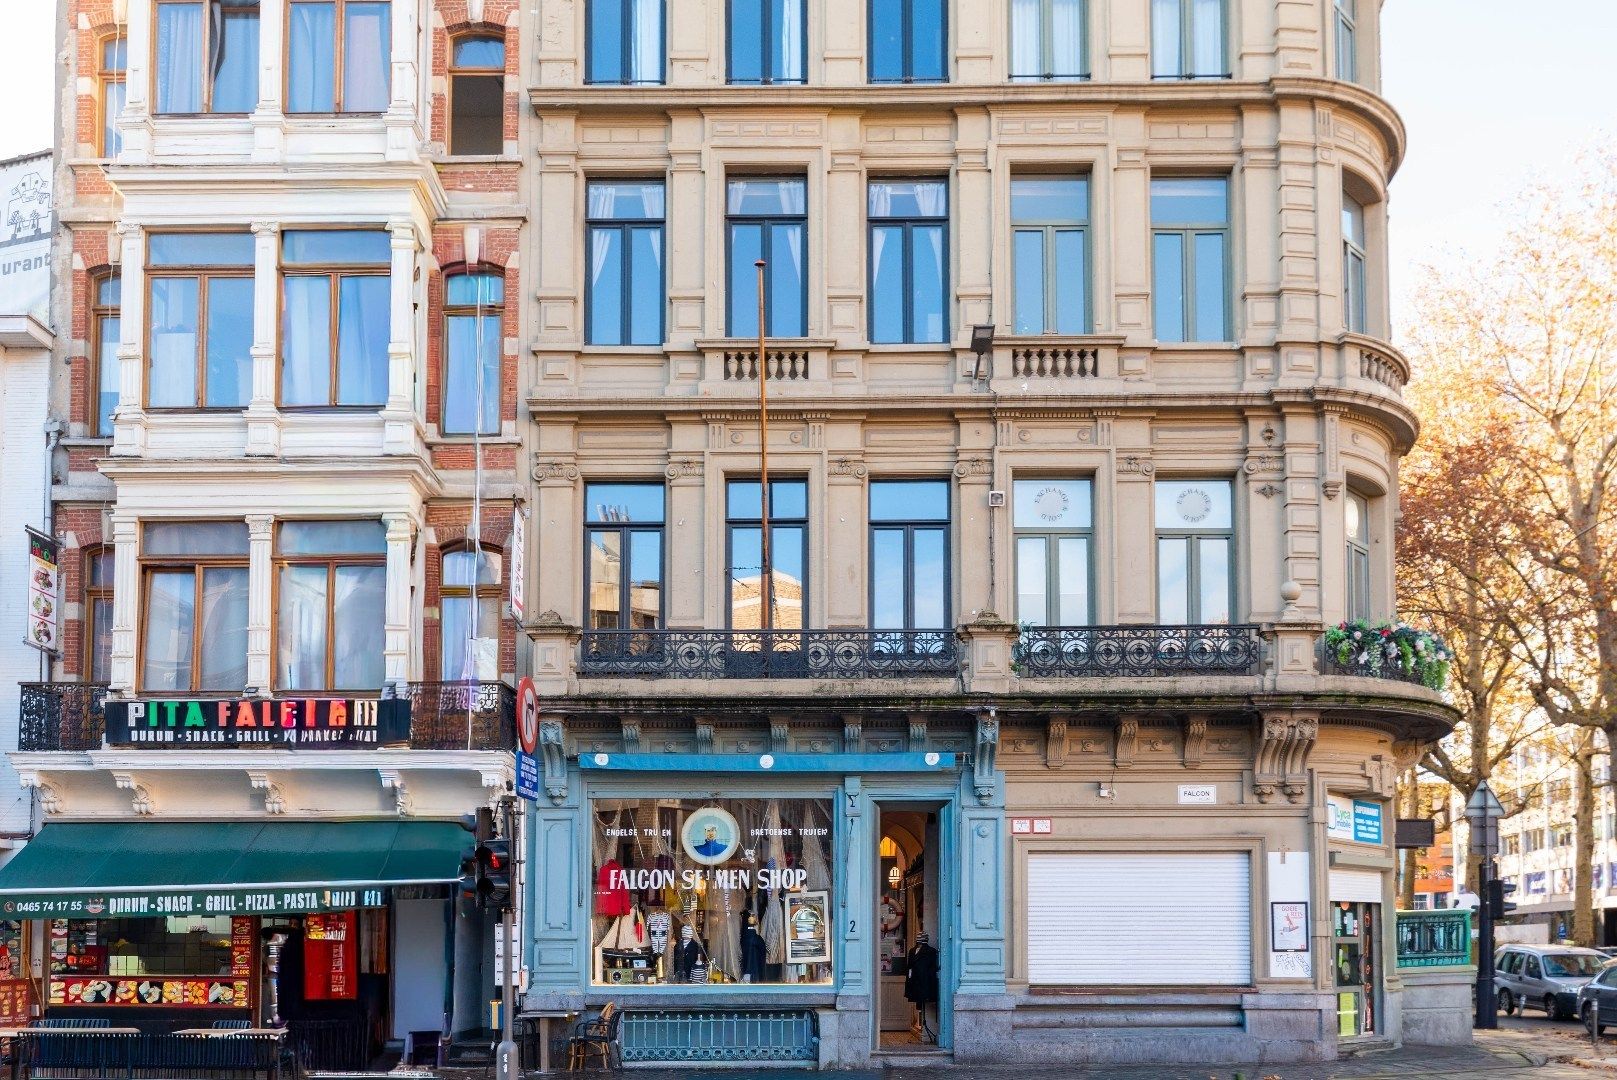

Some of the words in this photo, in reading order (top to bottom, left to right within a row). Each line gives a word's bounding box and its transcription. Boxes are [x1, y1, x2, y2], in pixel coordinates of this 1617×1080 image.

[128, 701, 205, 727] PITA
[236, 730, 270, 742] GRILL
[643, 828, 672, 837] TRUEN
[609, 868, 675, 890] FALCON
[757, 868, 807, 890] SHOP
[16, 902, 40, 912] 0465
[42, 901, 54, 912] 74
[56, 901, 68, 911] 17
[70, 900, 83, 911] 55
[205, 895, 237, 911] GRILL
[245, 894, 276, 911] PIZZA
[283, 892, 318, 909] PASTA
[849, 920, 856, 932] 2
